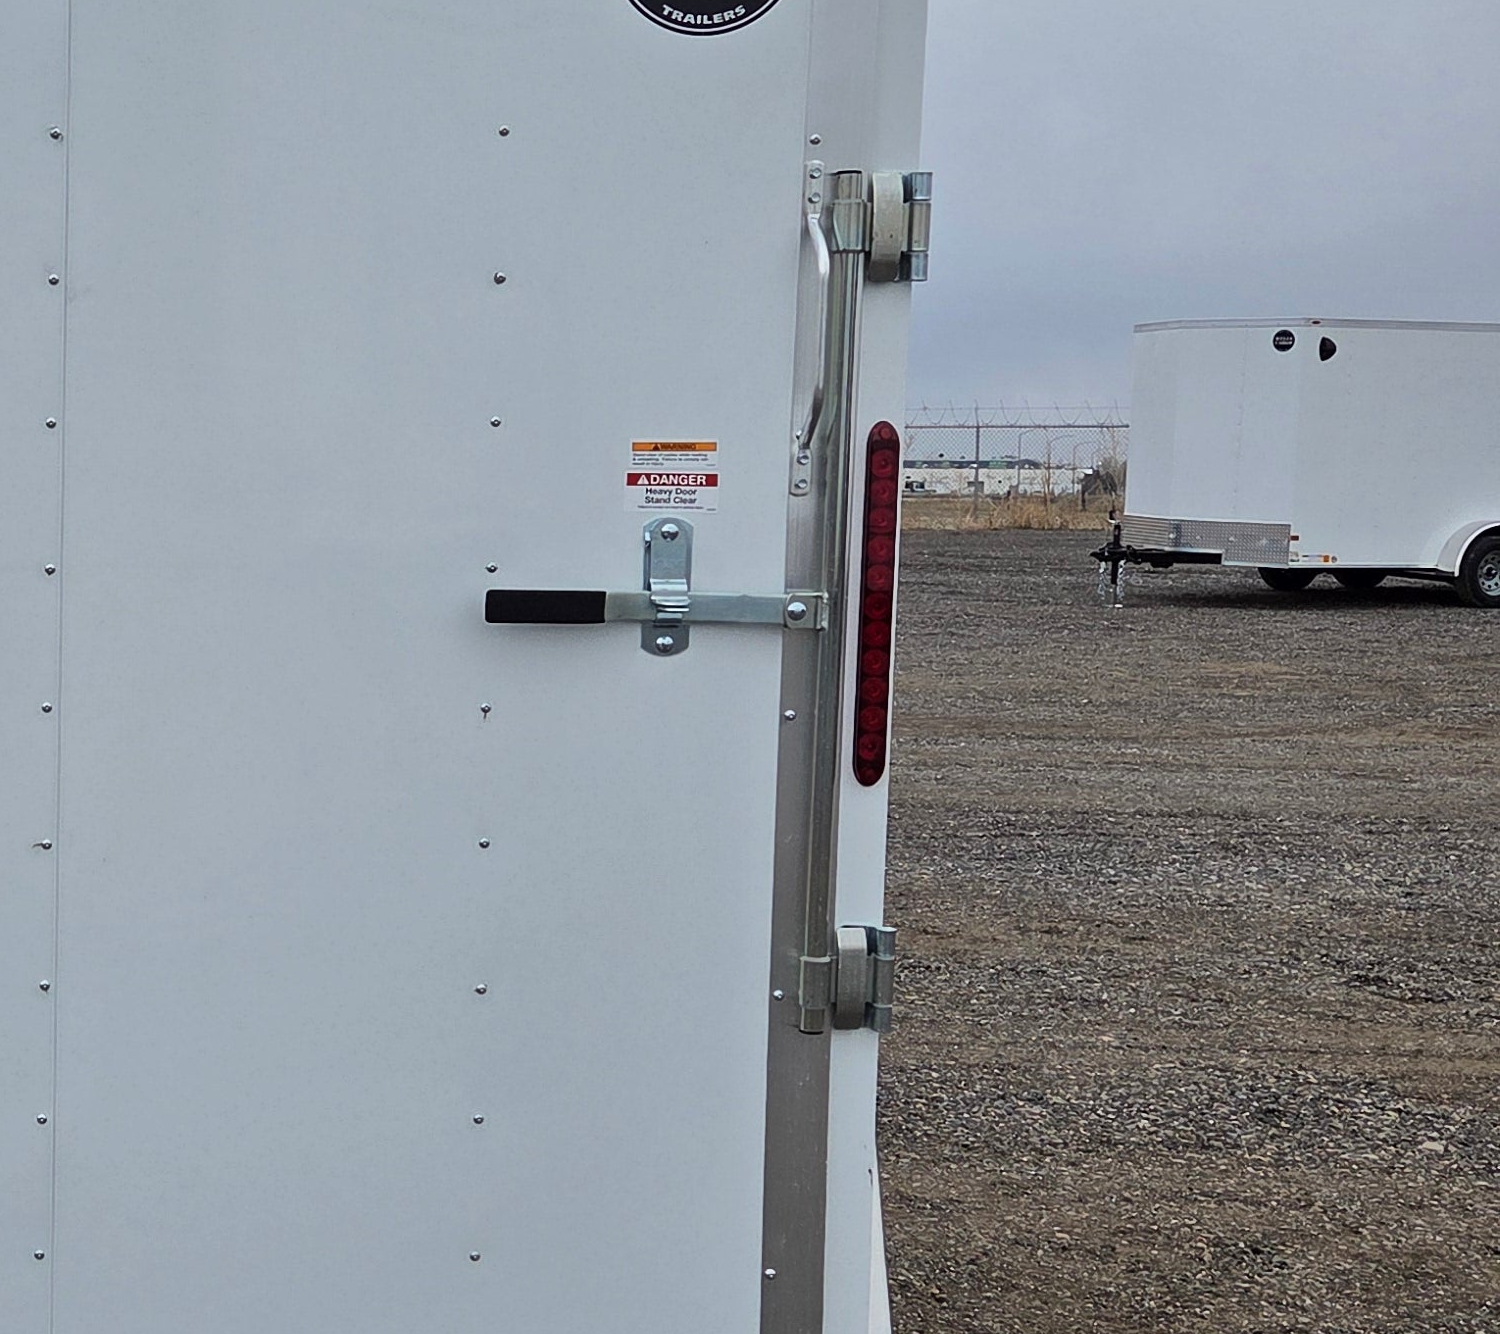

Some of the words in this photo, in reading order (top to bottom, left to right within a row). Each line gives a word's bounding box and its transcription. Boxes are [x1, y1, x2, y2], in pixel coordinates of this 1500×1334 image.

[662, 4, 746, 25] TRAILERS
[650, 474, 707, 486] DANGER
[645, 487, 673, 497] Heavy
[674, 488, 698, 496] Door
[644, 496, 671, 504] Stand
[673, 496, 697, 505] Clear
